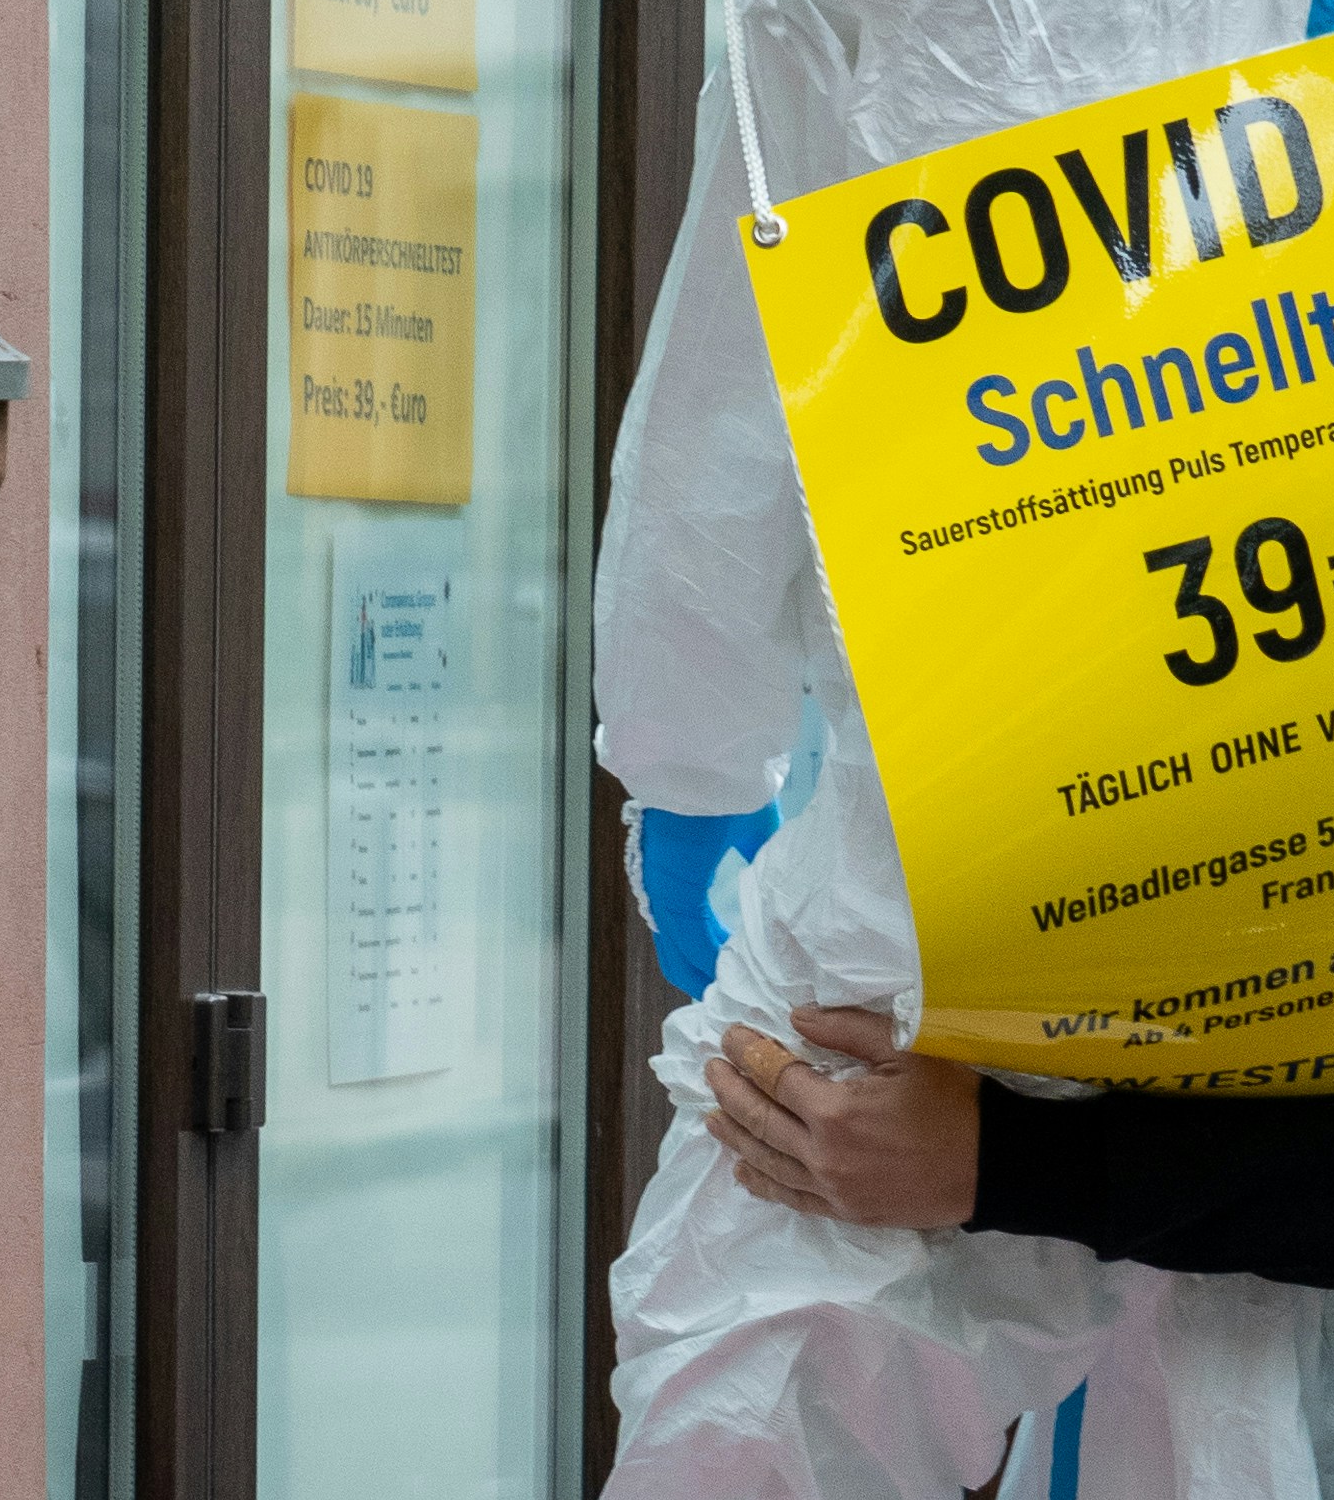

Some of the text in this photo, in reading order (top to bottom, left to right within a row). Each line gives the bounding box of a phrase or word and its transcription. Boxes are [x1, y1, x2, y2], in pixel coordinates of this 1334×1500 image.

[304, 157, 373, 198] COVID 19
[303, 226, 463, 275] ANTIKÖRPERSCHNELLTEST
[864, 98, 1323, 344] COVID
[303, 297, 434, 343] Dauer: 15 Minuten
[303, 375, 349, 418] Preis:
[900, 469, 1165, 556] Sauerstoffsättigung
[1169, 450, 1226, 484] Puls
[1057, 752, 1193, 817] TÄGLICH
[1210, 721, 1302, 774] OHNE
[1031, 833, 1307, 933] Weißadlergasse
[1042, 1009, 1120, 1039] Wir
[1132, 959, 1315, 1023] kommen
[1122, 1031, 1163, 1049] Ab
[1176, 1023, 1193, 1037] 4
